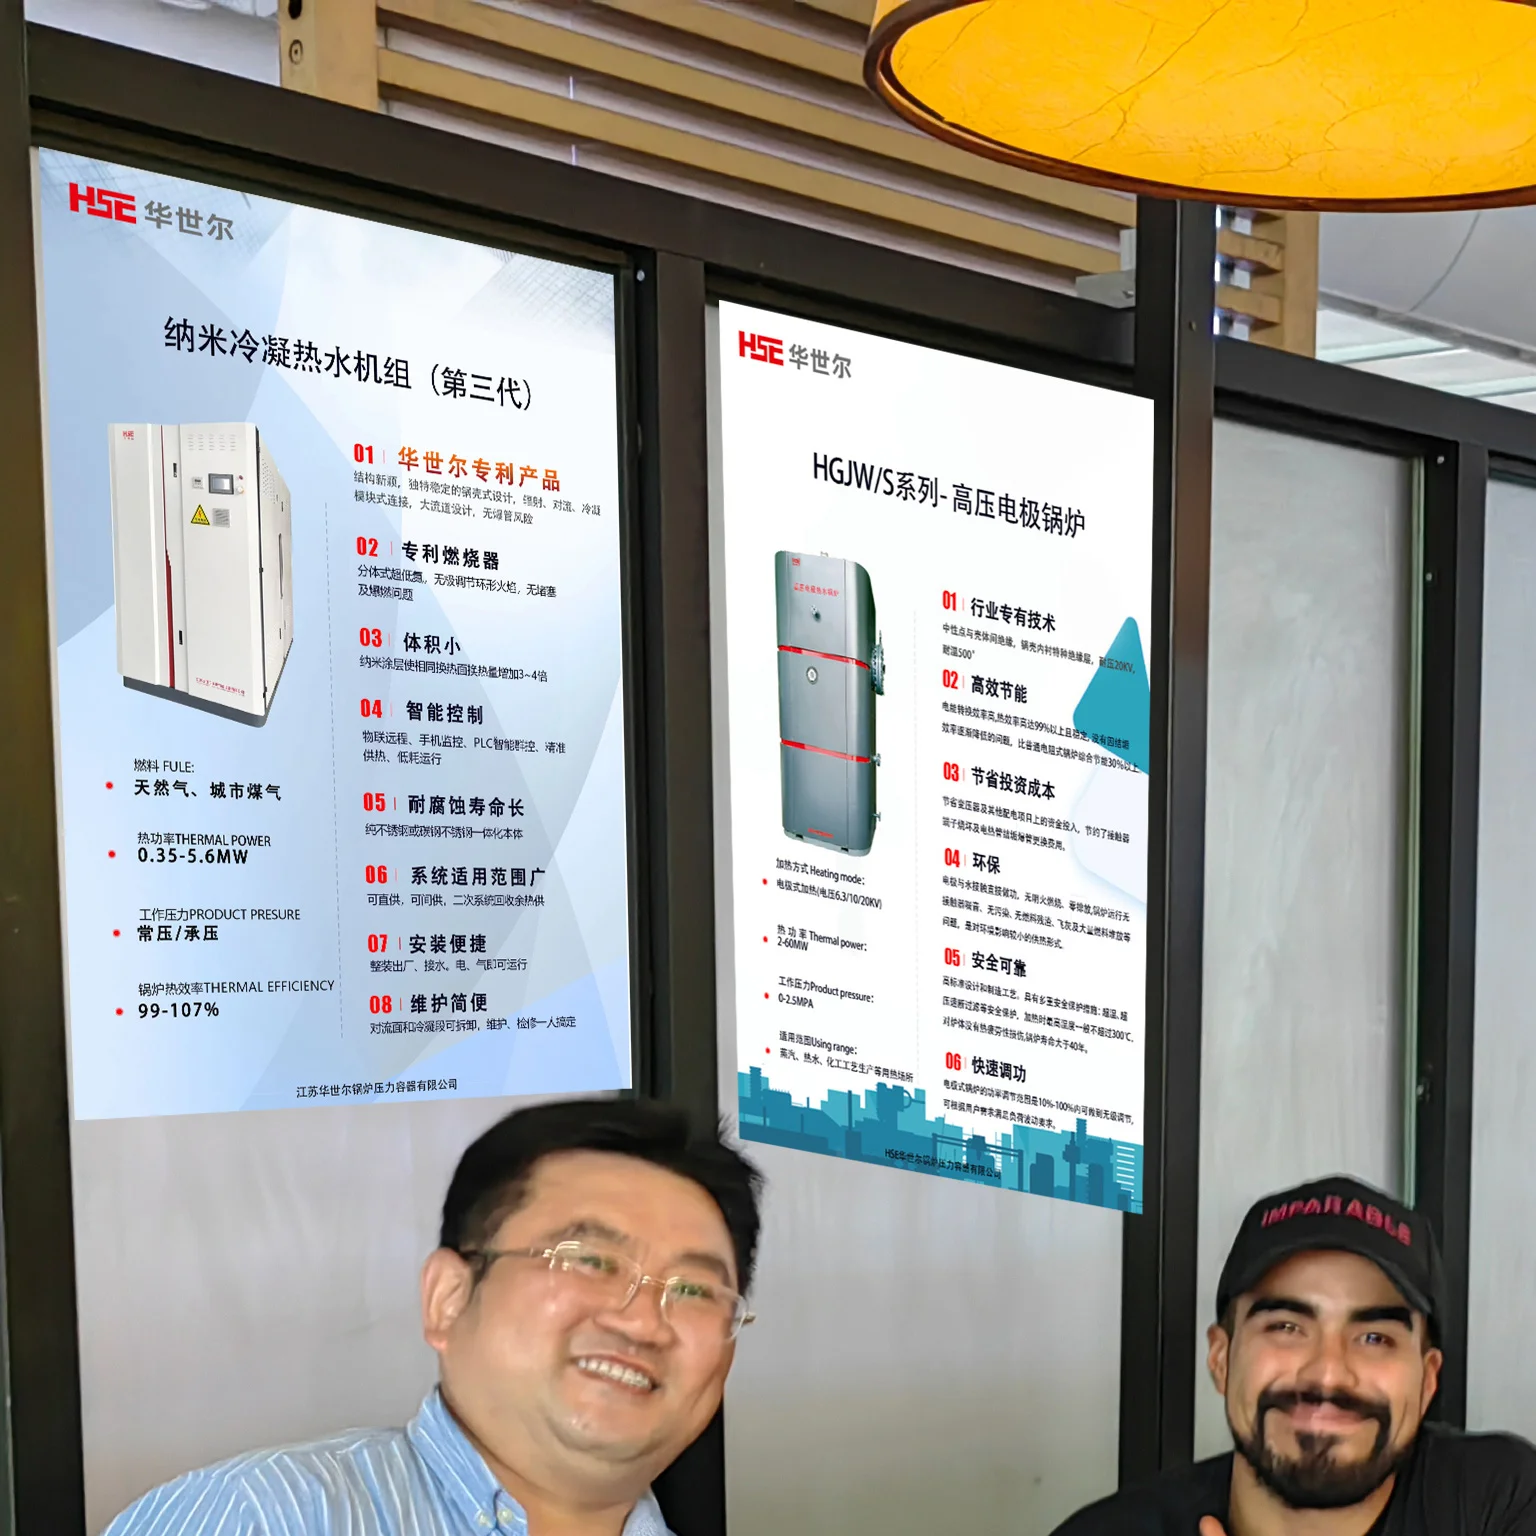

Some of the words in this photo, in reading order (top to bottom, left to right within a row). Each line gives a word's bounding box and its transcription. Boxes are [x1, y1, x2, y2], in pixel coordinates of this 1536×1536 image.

[68, 182, 137, 225] HSE
[143, 200, 234, 241] 华世尔
[738, 330, 785, 367] HSE
[788, 344, 852, 379] 华世尔
[353, 443, 374, 464] 01
[397, 445, 561, 492] 华世尔专利产品
[356, 536, 378, 557] 02
[401, 541, 500, 571] 专利燃烧器
[942, 590, 957, 611] 01
[971, 597, 1056, 633] 行业专有技术
[359, 627, 382, 648] 03
[403, 631, 461, 656] 体积小
[942, 669, 958, 690] 02
[971, 675, 1028, 704] 高效节能
[360, 698, 382, 719] 04
[406, 700, 484, 725] 智能控制
[133, 758, 160, 773] 燃料
[134, 779, 282, 801] 天然气、城市煤气
[943, 762, 960, 782] 03
[971, 766, 1056, 800] 节省投资成本
[363, 792, 386, 812] 05
[407, 794, 525, 818] 耐腐蚀寿命长
[231, 835, 271, 847] POWER
[137, 847, 249, 865] 0.35-5.6MW
[944, 848, 960, 868] 04
[972, 851, 1001, 875] 环保
[365, 865, 388, 884] 06
[411, 866, 546, 887] 系统适用范围广
[776, 857, 809, 875] 加热方式
[809, 865, 839, 883] Heating
[250, 909, 301, 921] PRESURE
[137, 925, 219, 942] 常压/承压
[368, 934, 388, 953] 07
[408, 933, 487, 955] 安装便捷
[777, 936, 809, 952] 2-60MW
[809, 930, 840, 946] Thermal
[944, 947, 961, 967] 05
[971, 951, 1027, 978] 安全可靠
[267, 980, 335, 993] EFFICIENCY
[138, 1001, 220, 1019] 99-107%
[369, 995, 392, 1014] 08
[410, 993, 488, 1014] 维护简便
[778, 993, 814, 1009] 0-2.5MPA
[945, 1051, 962, 1071] 06
[971, 1056, 1027, 1083] 快速调功
[296, 1078, 458, 1098] 江苏华世尔锅炉压力容器有限公司
[1261, 1194, 1412, 1247] IMPARABLE
